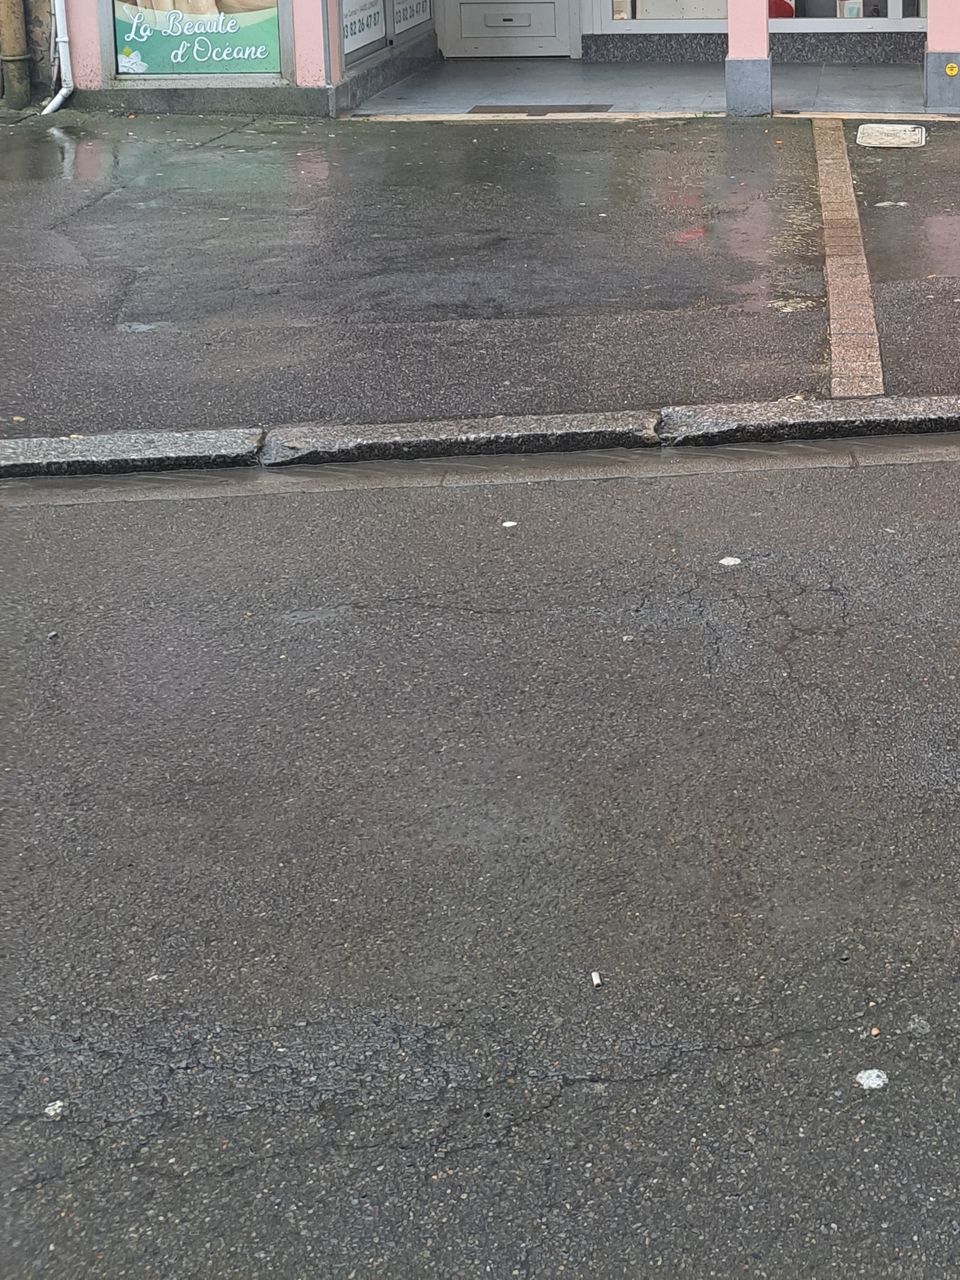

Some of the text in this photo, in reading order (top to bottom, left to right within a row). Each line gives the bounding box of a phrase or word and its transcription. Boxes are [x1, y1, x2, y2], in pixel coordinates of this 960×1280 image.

[123, 5, 240, 42] La Beauté
[170, 36, 269, 63] d'Océane
